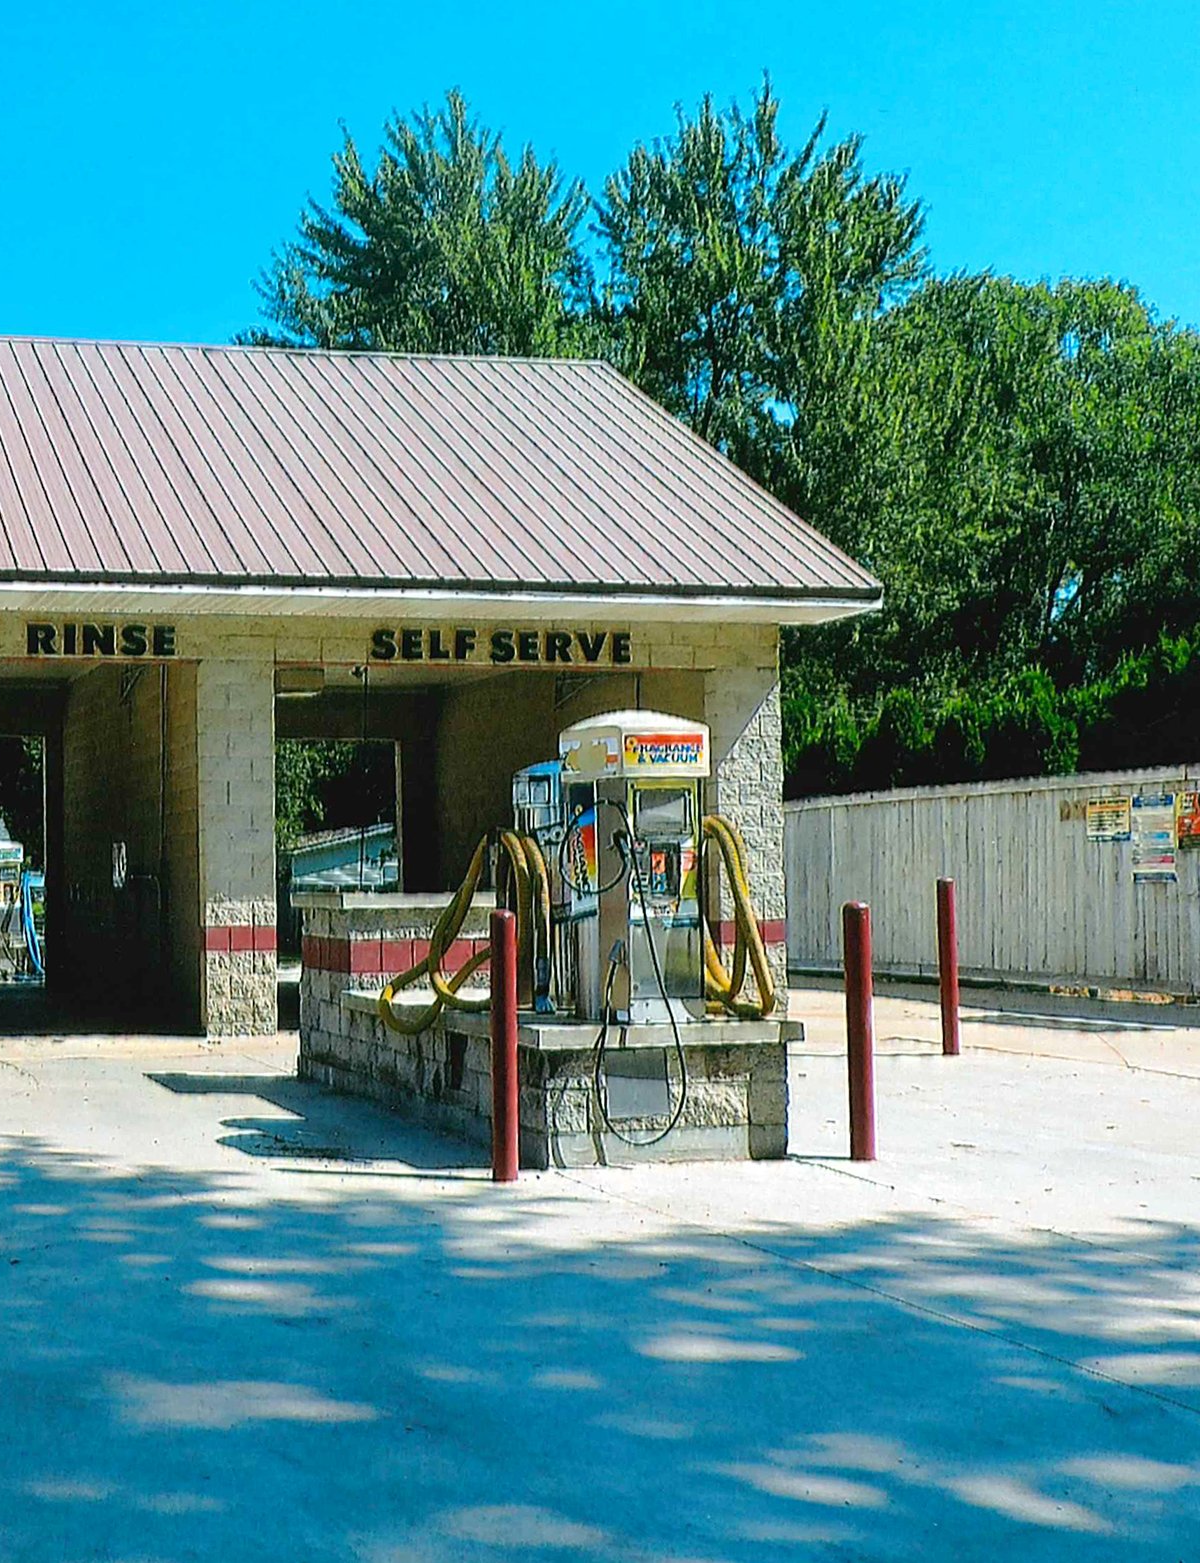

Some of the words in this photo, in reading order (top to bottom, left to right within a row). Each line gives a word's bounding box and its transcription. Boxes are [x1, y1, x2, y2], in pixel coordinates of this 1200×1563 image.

[26, 622, 176, 657] RINSE
[371, 627, 478, 660] SELF
[490, 630, 632, 663] SERVE
[649, 753, 698, 764] VACUUM
